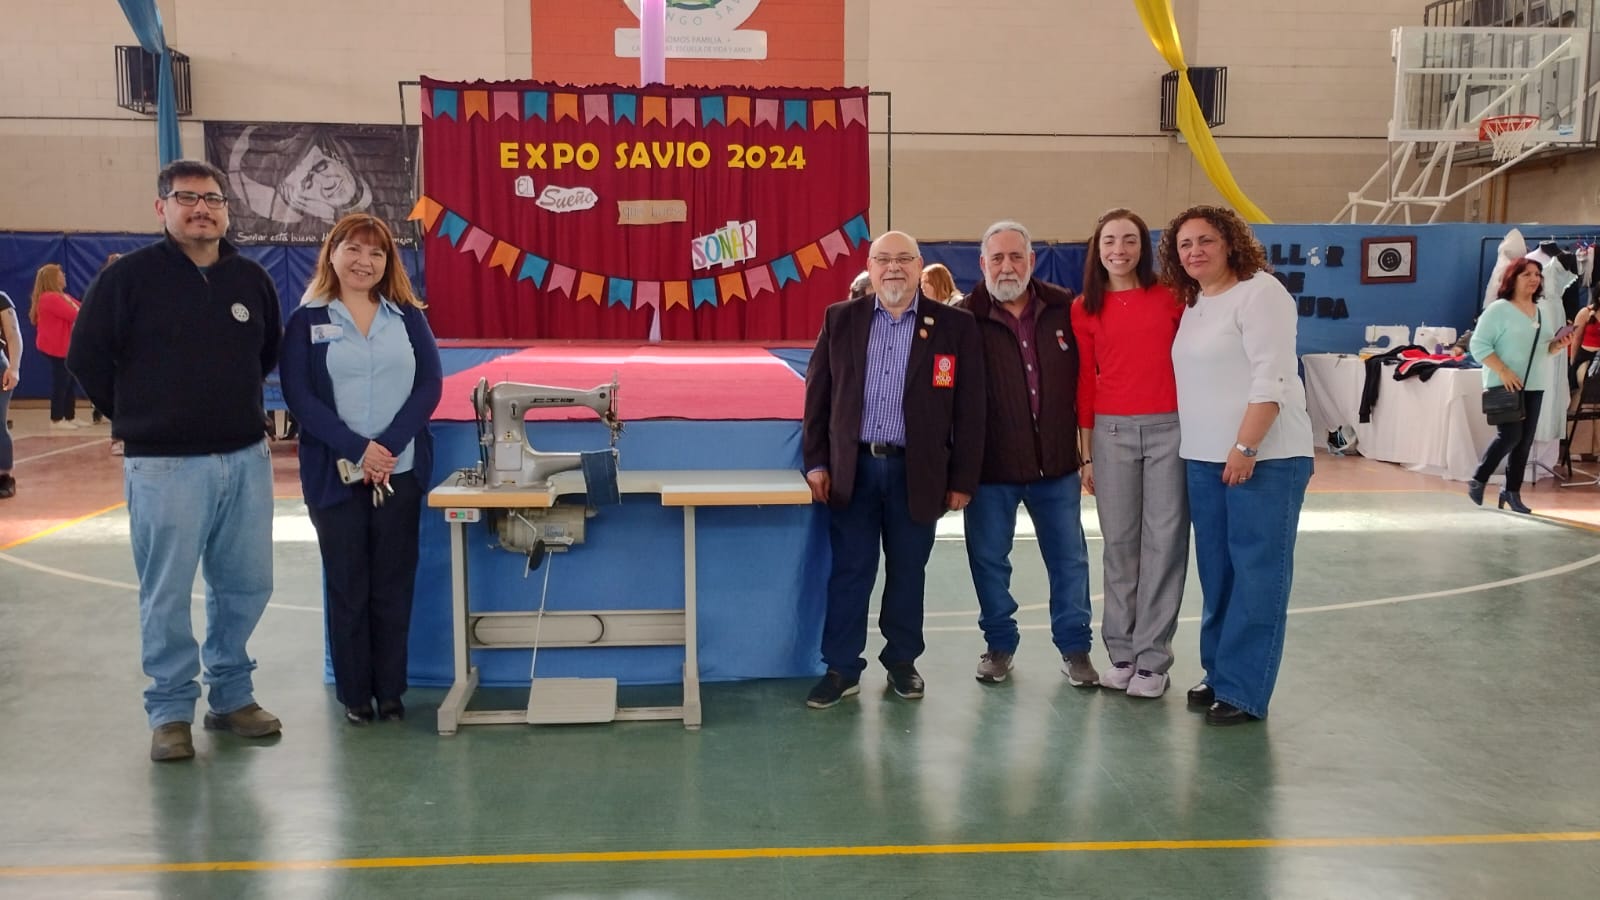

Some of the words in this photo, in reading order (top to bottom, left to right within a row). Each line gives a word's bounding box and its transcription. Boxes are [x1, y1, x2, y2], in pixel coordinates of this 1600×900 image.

[500, 142, 600, 170] EXPO
[615, 141, 711, 170] SAVIO
[727, 144, 806, 170] 2024
[540, 188, 593, 209] Sueño
[692, 223, 755, 268] SOÑAR
